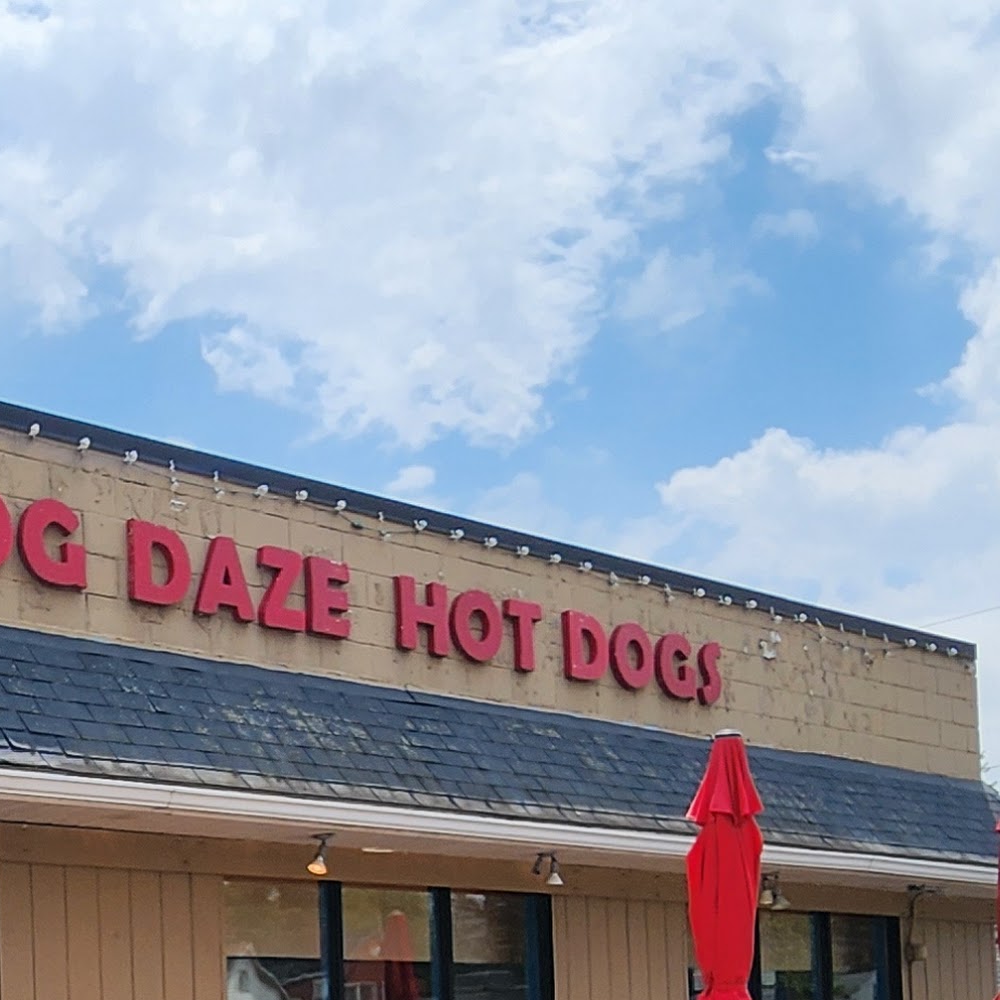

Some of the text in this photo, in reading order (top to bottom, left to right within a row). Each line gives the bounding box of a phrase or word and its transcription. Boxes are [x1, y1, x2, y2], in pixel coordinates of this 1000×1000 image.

[125, 517, 351, 640] DAZE
[392, 575, 542, 673] HOT
[561, 610, 722, 706] DOGS
